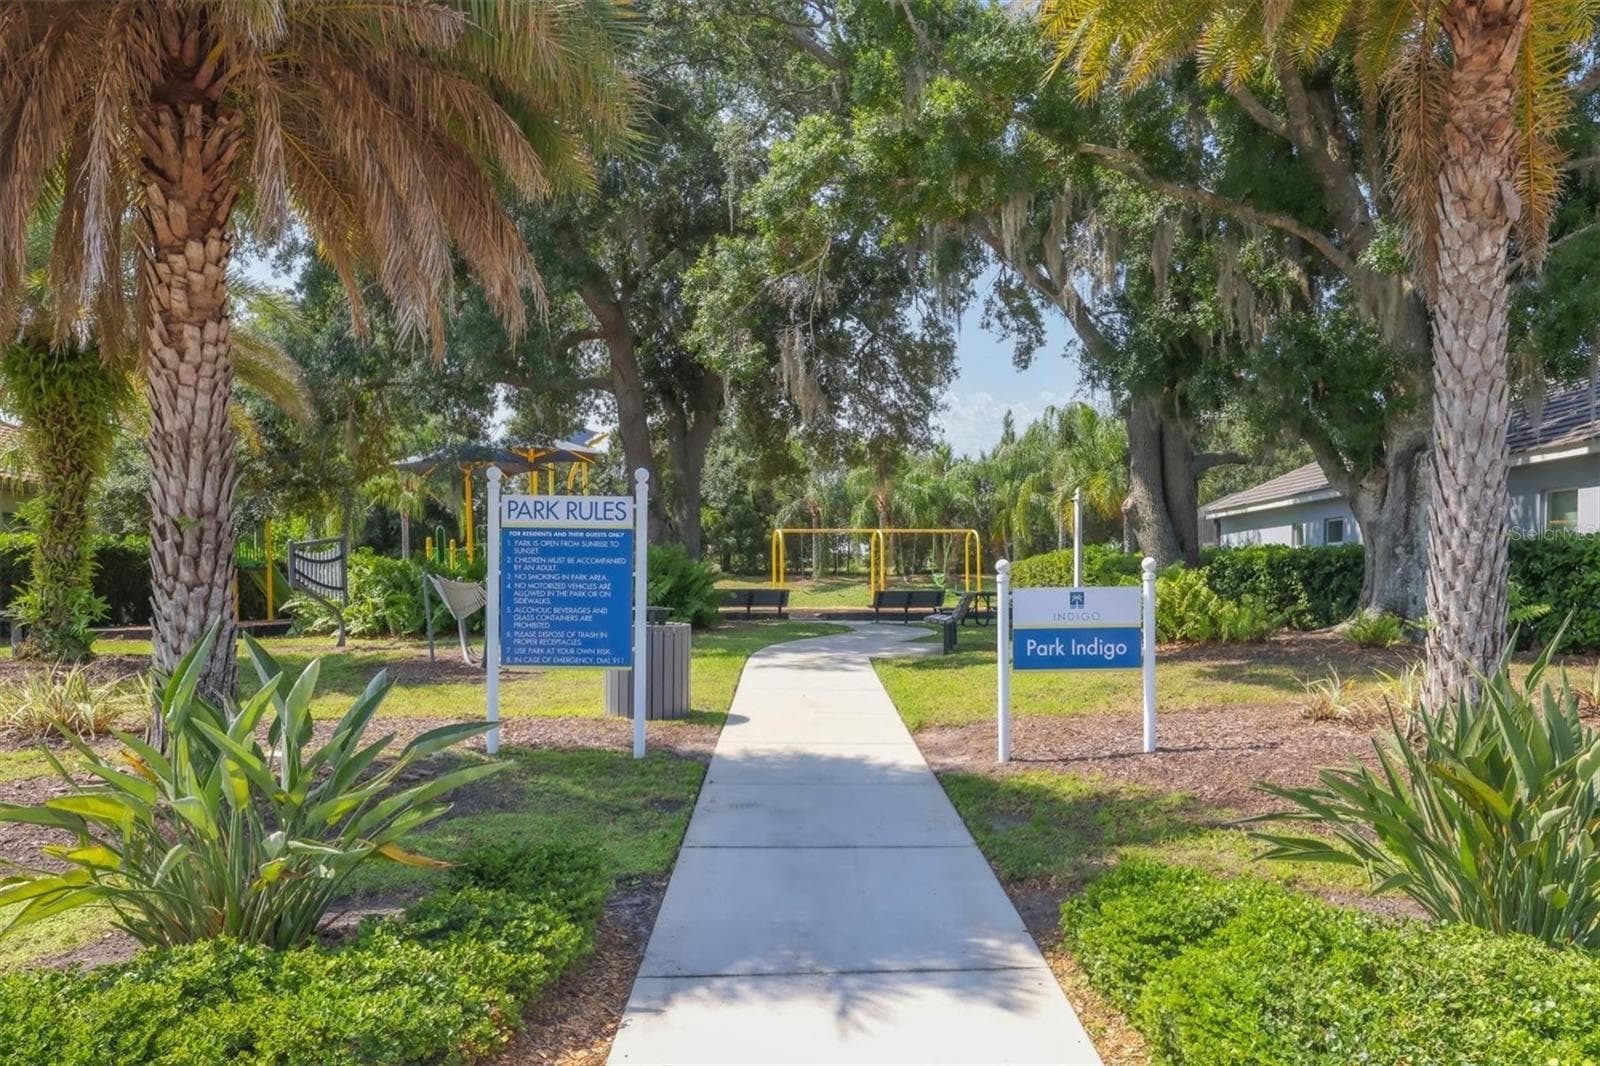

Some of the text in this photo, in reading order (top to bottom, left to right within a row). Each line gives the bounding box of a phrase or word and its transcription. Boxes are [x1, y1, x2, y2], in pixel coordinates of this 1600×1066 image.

[507, 500, 627, 521] PARK RULES
[1027, 637, 1127, 660] Park Indigo
